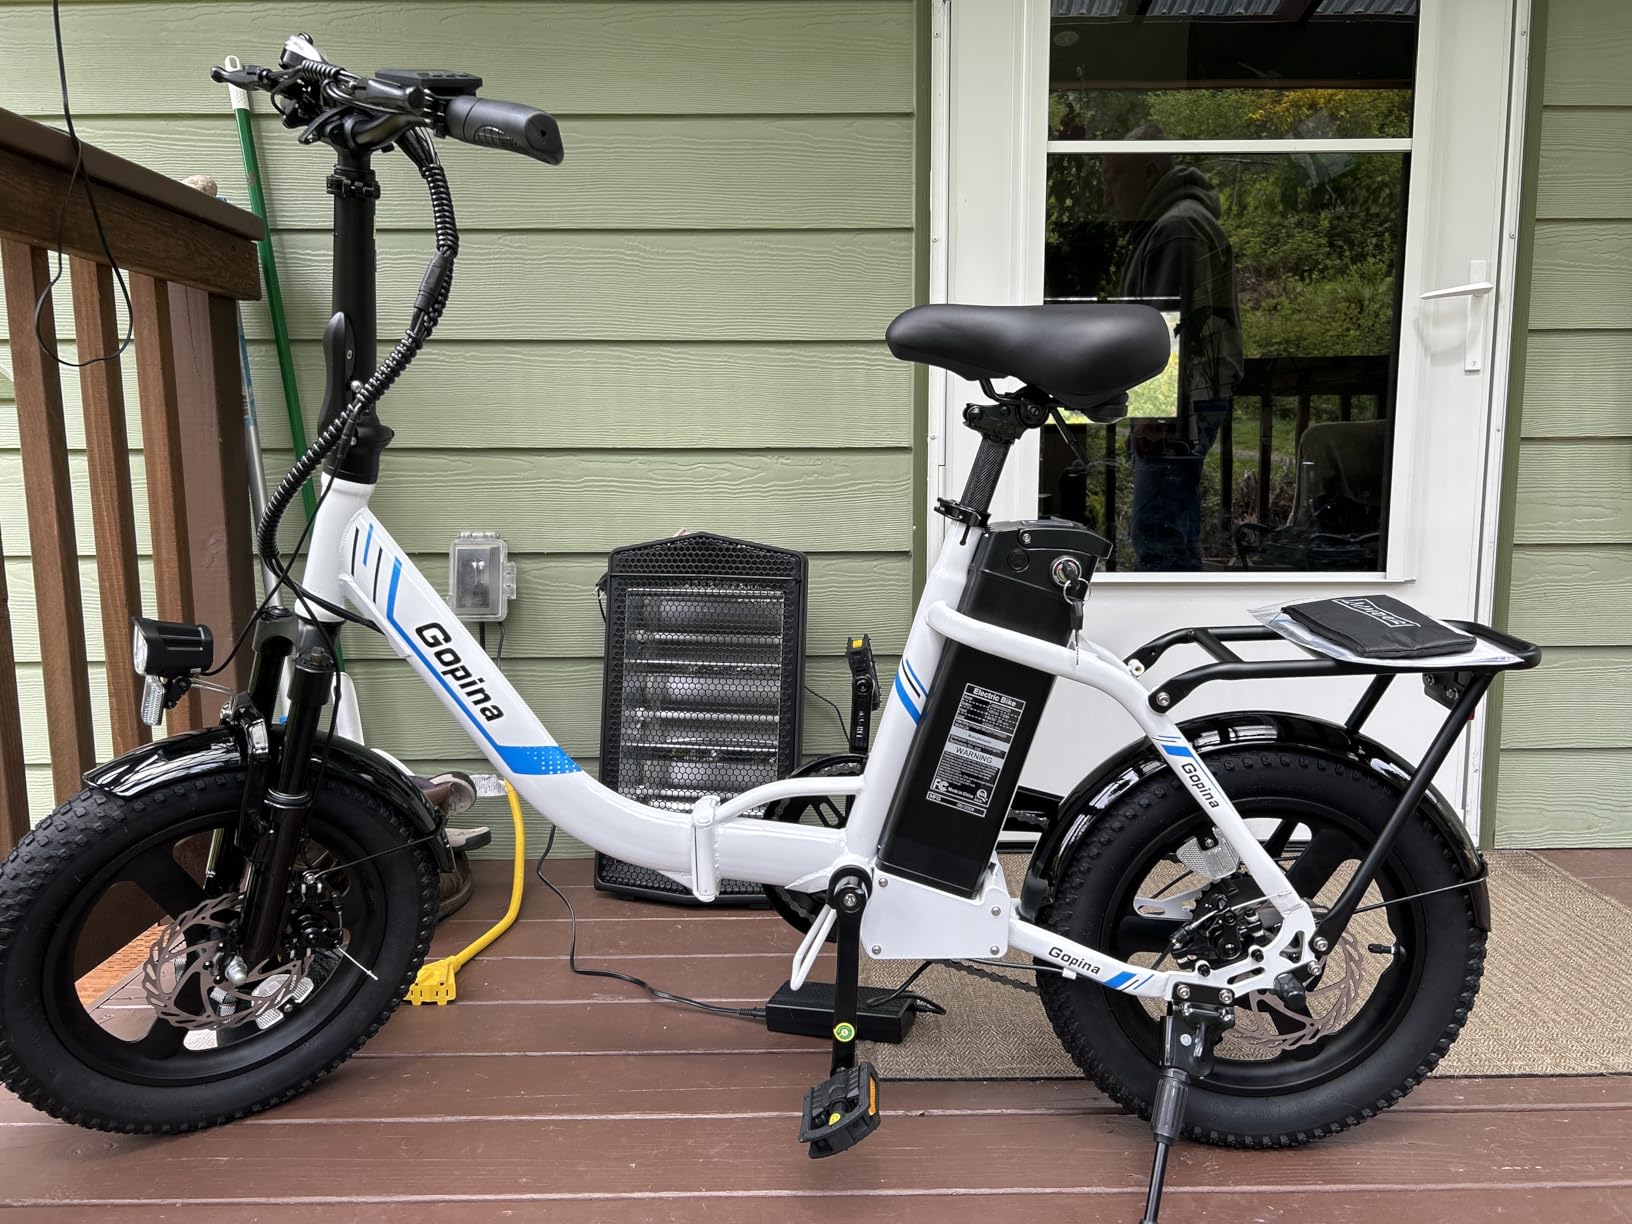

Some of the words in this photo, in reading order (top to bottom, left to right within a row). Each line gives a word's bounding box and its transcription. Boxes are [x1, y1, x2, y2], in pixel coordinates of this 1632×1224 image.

[415, 622, 504, 722] Gopina
[973, 687, 1000, 702] Electric
[1000, 696, 1017, 707] Bike
[956, 746, 993, 764] WARNING
[948, 787, 960, 795] Made
[962, 791, 974, 799] China
[1181, 762, 1220, 808] Gopina
[1048, 946, 1101, 975] Gopina
